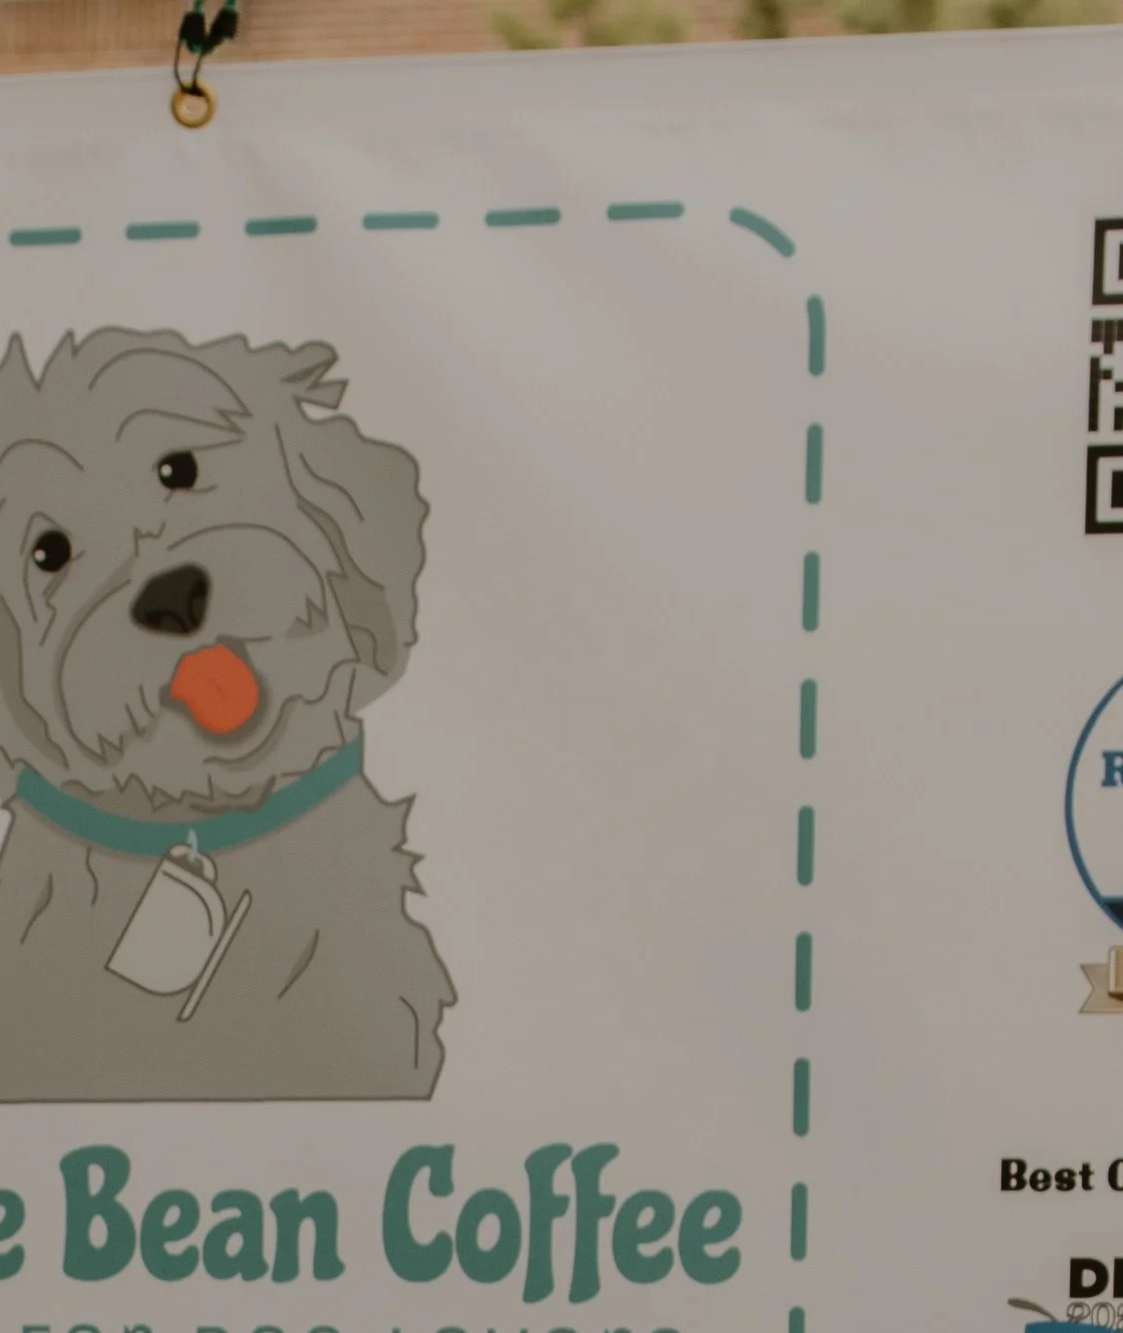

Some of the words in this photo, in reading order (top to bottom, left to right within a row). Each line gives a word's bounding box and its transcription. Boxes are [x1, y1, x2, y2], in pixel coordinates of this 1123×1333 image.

[59, 1145, 345, 1283] Bean
[382, 1143, 742, 1304] Coffee
[1001, 1159, 1093, 1192] Best
